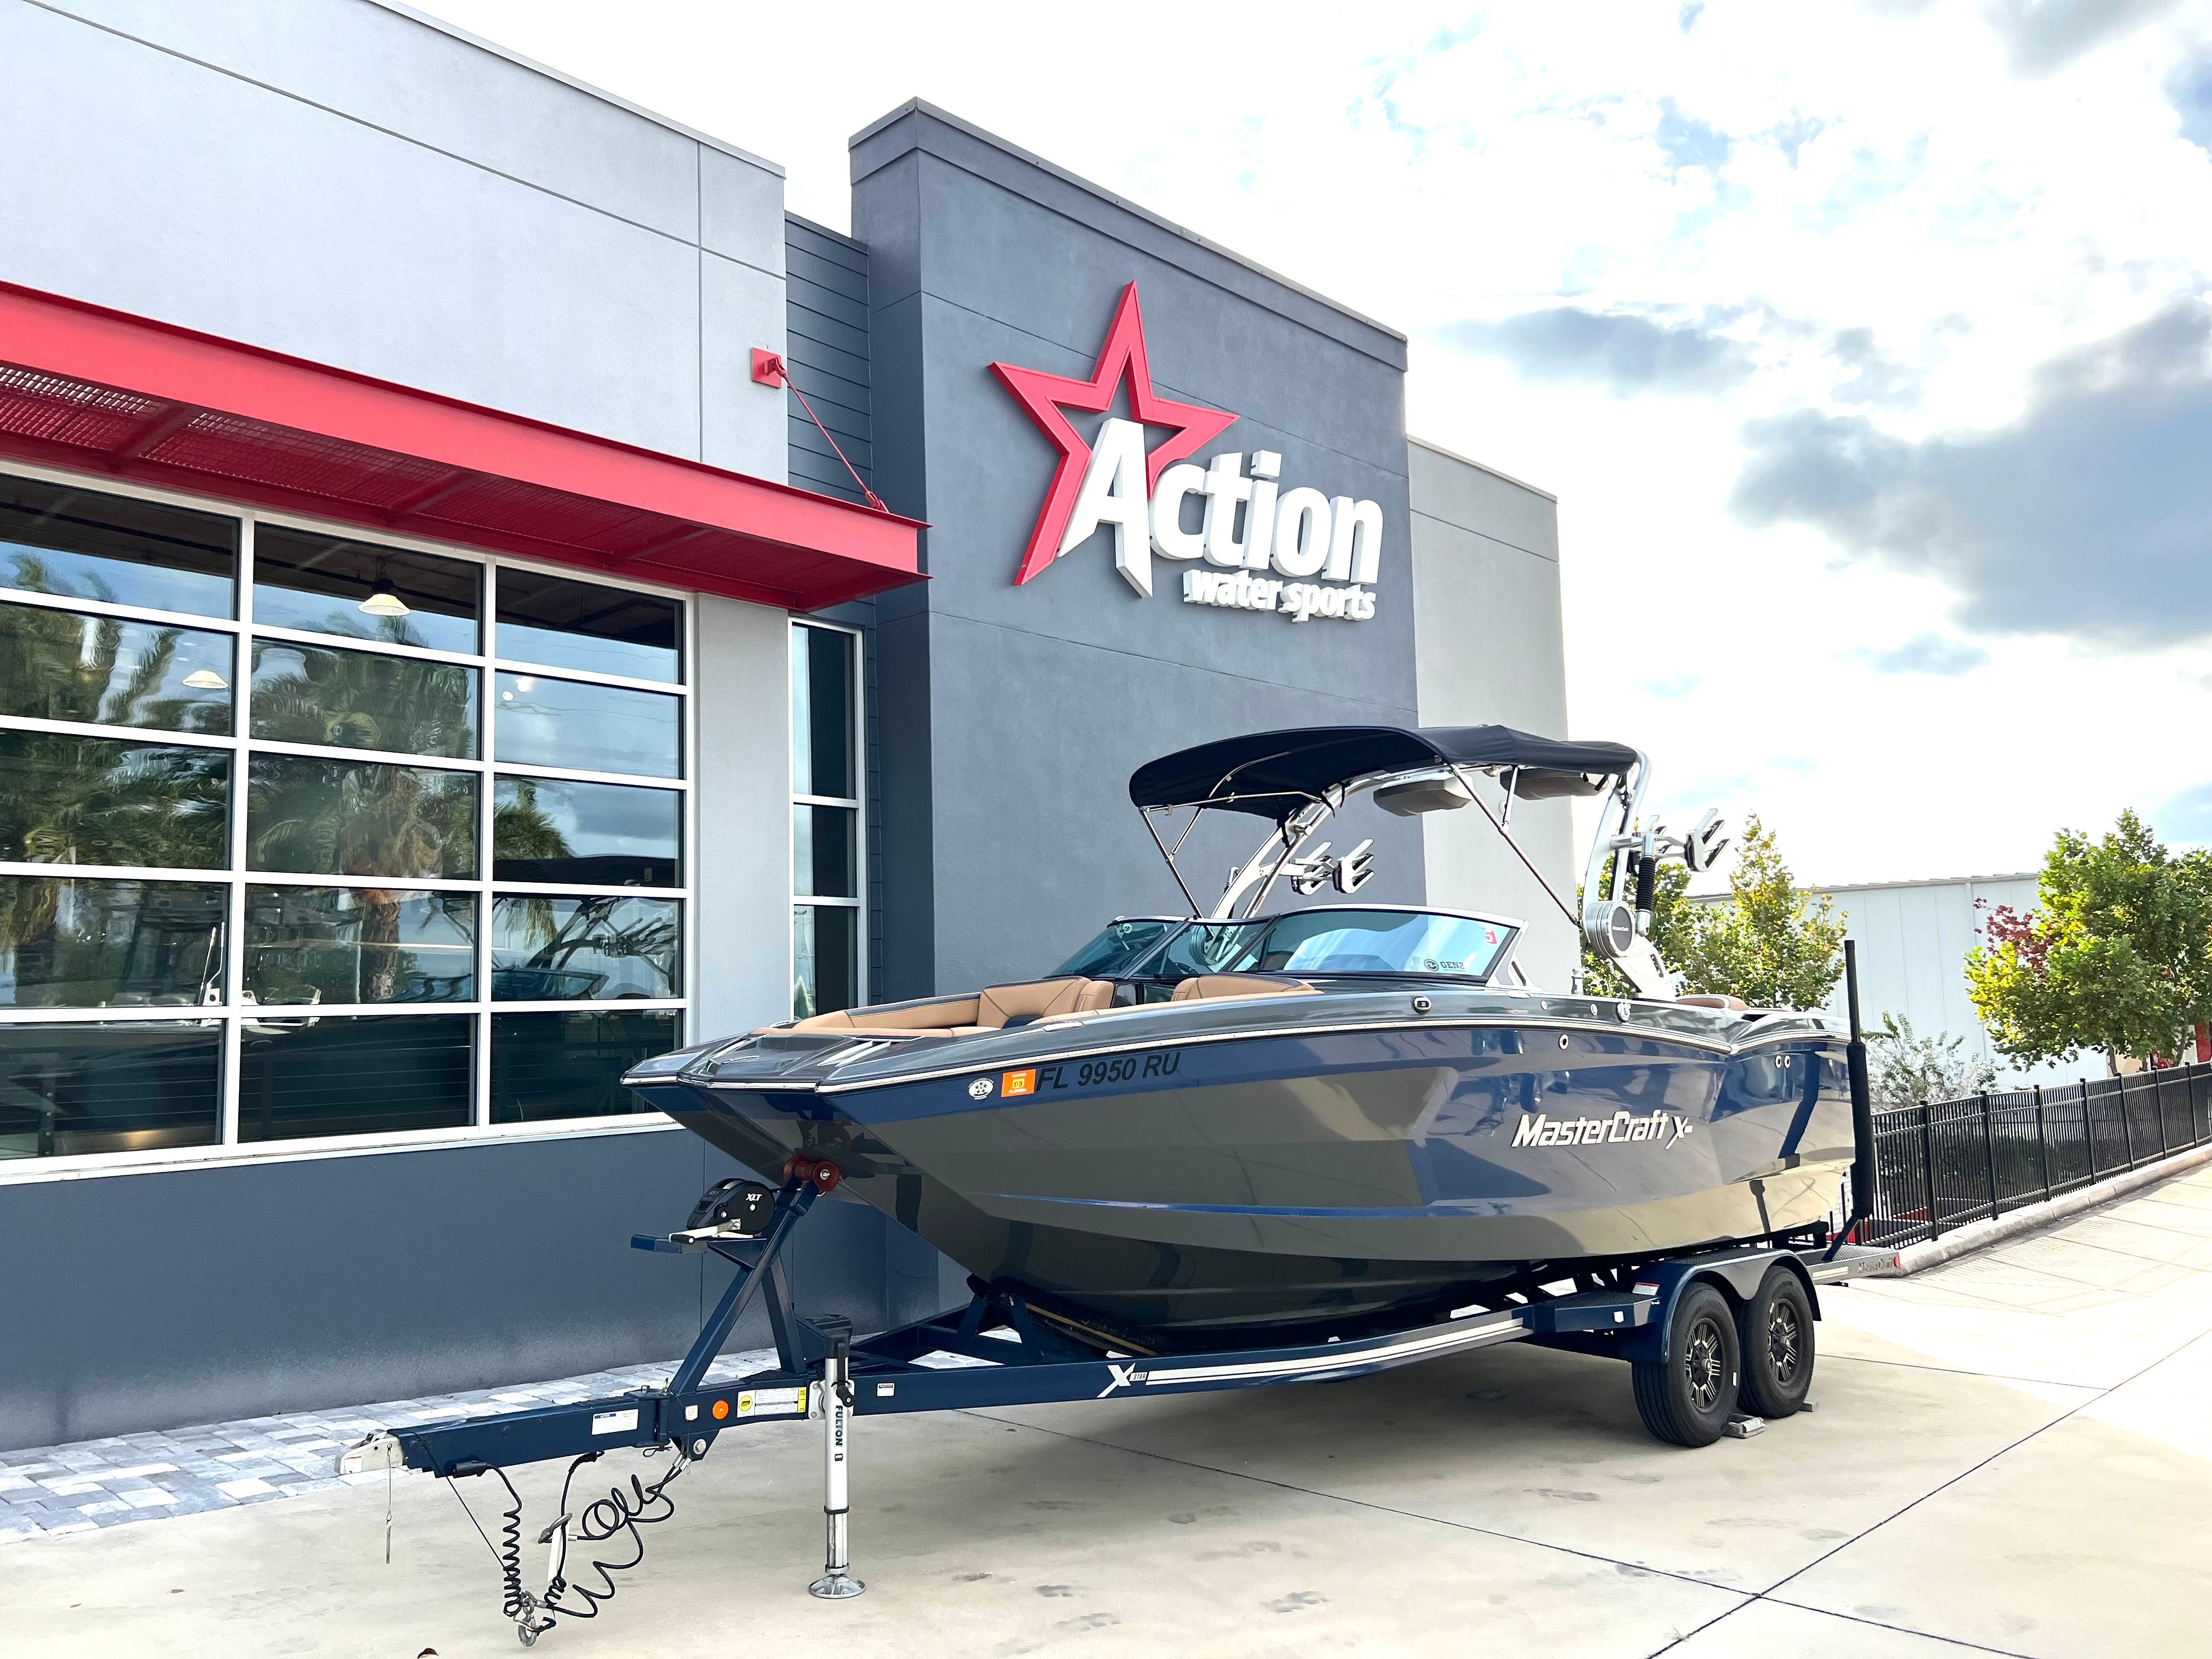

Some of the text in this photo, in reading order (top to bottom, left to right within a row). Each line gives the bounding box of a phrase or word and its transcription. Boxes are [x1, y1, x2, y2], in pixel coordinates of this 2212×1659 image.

[1059, 418, 1383, 599] Action
[1184, 569, 1376, 623] water sports
[1036, 1052, 1182, 1092] FL 9950 RU
[1511, 1109, 1668, 1147] MasterCraft
[746, 1193, 762, 1201] XLT
